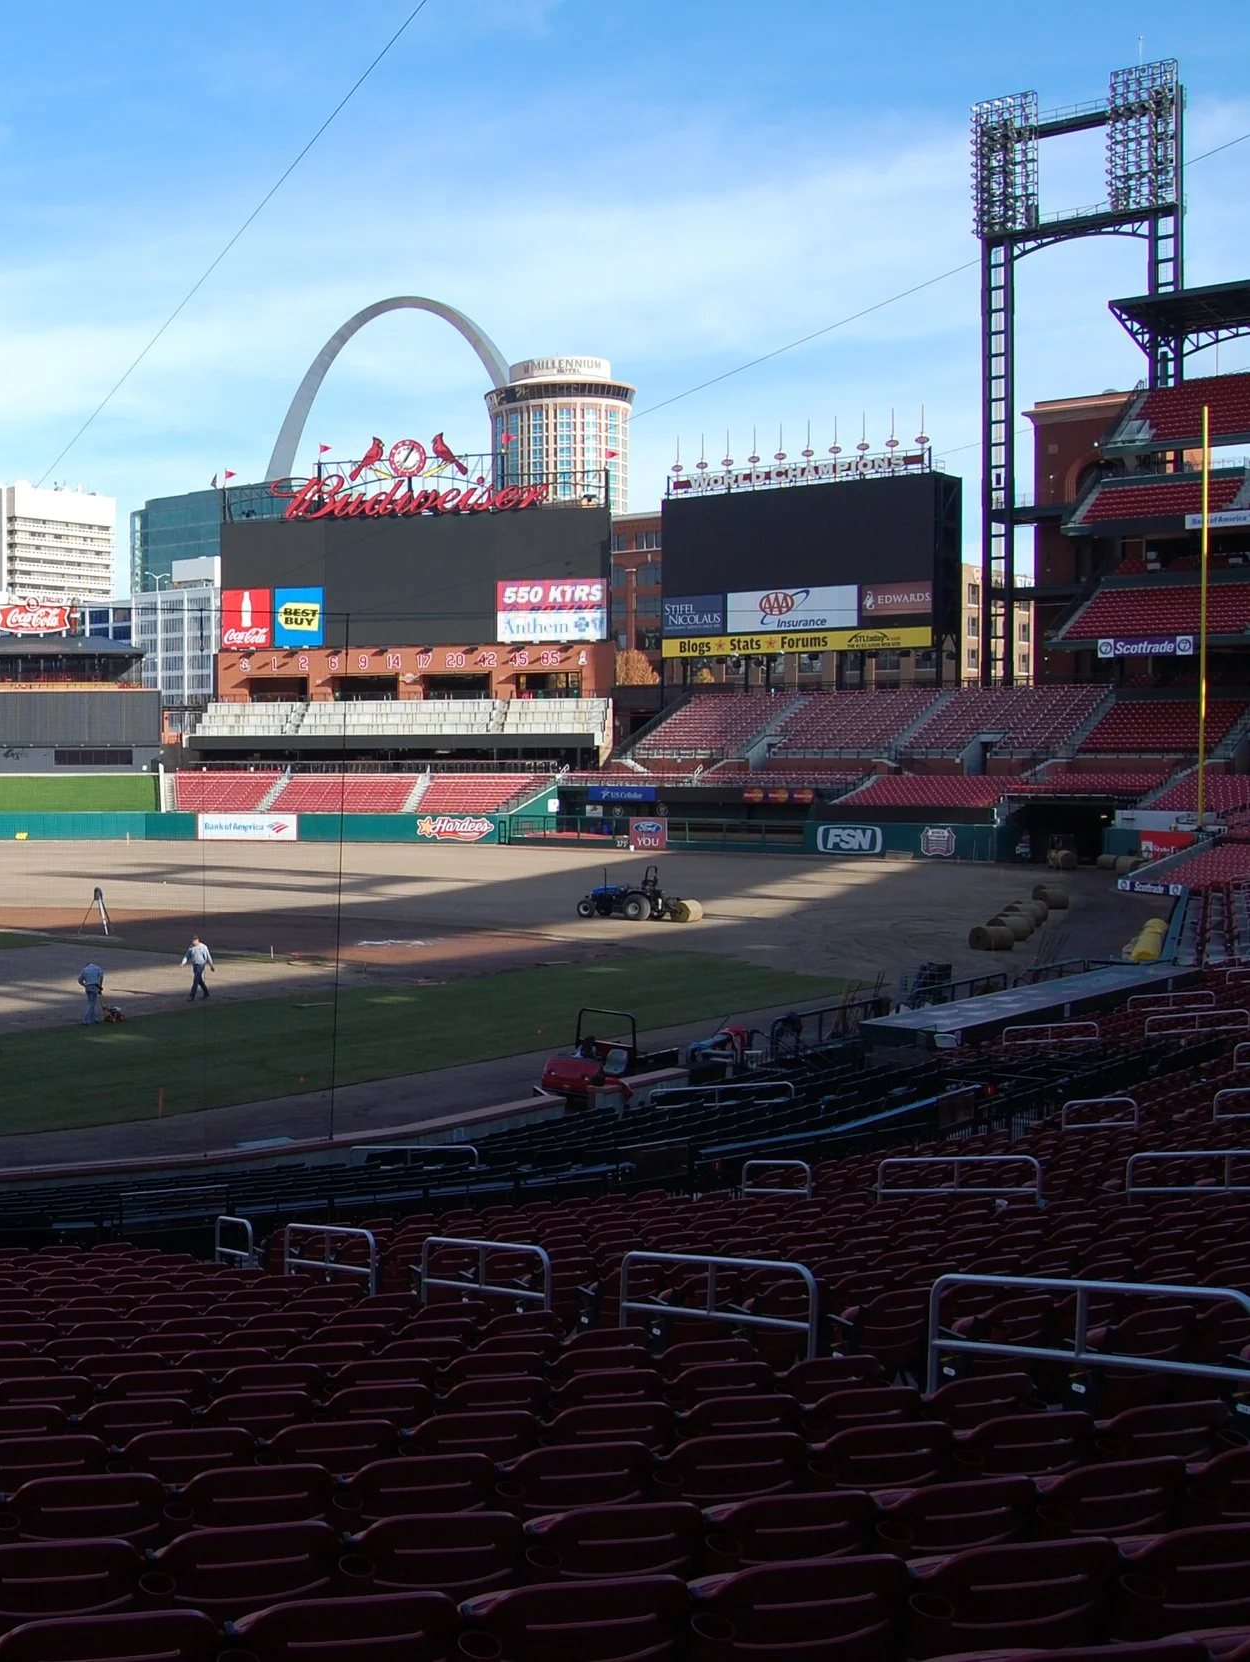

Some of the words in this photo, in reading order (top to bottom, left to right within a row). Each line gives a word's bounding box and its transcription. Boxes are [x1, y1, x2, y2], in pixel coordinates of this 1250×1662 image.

[533, 359, 601, 370] MILLENNIUM
[690, 470, 766, 492] WORLD
[770, 455, 906, 482] CHAMPIONS
[270, 475, 549, 519] Budweiser
[503, 586, 544, 604] 550
[549, 584, 603, 603] KTRS
[877, 592, 931, 604] EDWARDS
[664, 603, 696, 616] STIFEL
[762, 592, 791, 616] AAA
[284, 607, 319, 618] BEST
[284, 617, 314, 626] BUY
[503, 617, 569, 635] Anthem
[668, 613, 721, 626] NICOLAUS
[777, 617, 827, 628] Insurance
[679, 639, 711, 655] Blogs
[729, 637, 761, 652] Stats
[781, 635, 828, 650] Forums
[1115, 641, 1174, 655] Scottrade
[271, 656, 278, 671] 1
[299, 656, 308, 671] 2
[328, 655, 338, 670] 6
[359, 655, 368, 670] 9
[386, 654, 401, 669] 14
[416, 653, 432, 668] 17
[446, 652, 465, 668] 20
[477, 652, 497, 667] 42
[509, 651, 528, 667] 45
[541, 650, 560, 665] 85
[204, 822, 224, 831] Bank
[224, 822, 232, 830] of
[636, 823, 658, 833] Ford
[637, 838, 659, 847] YOU
[827, 828, 872, 849] FSN
